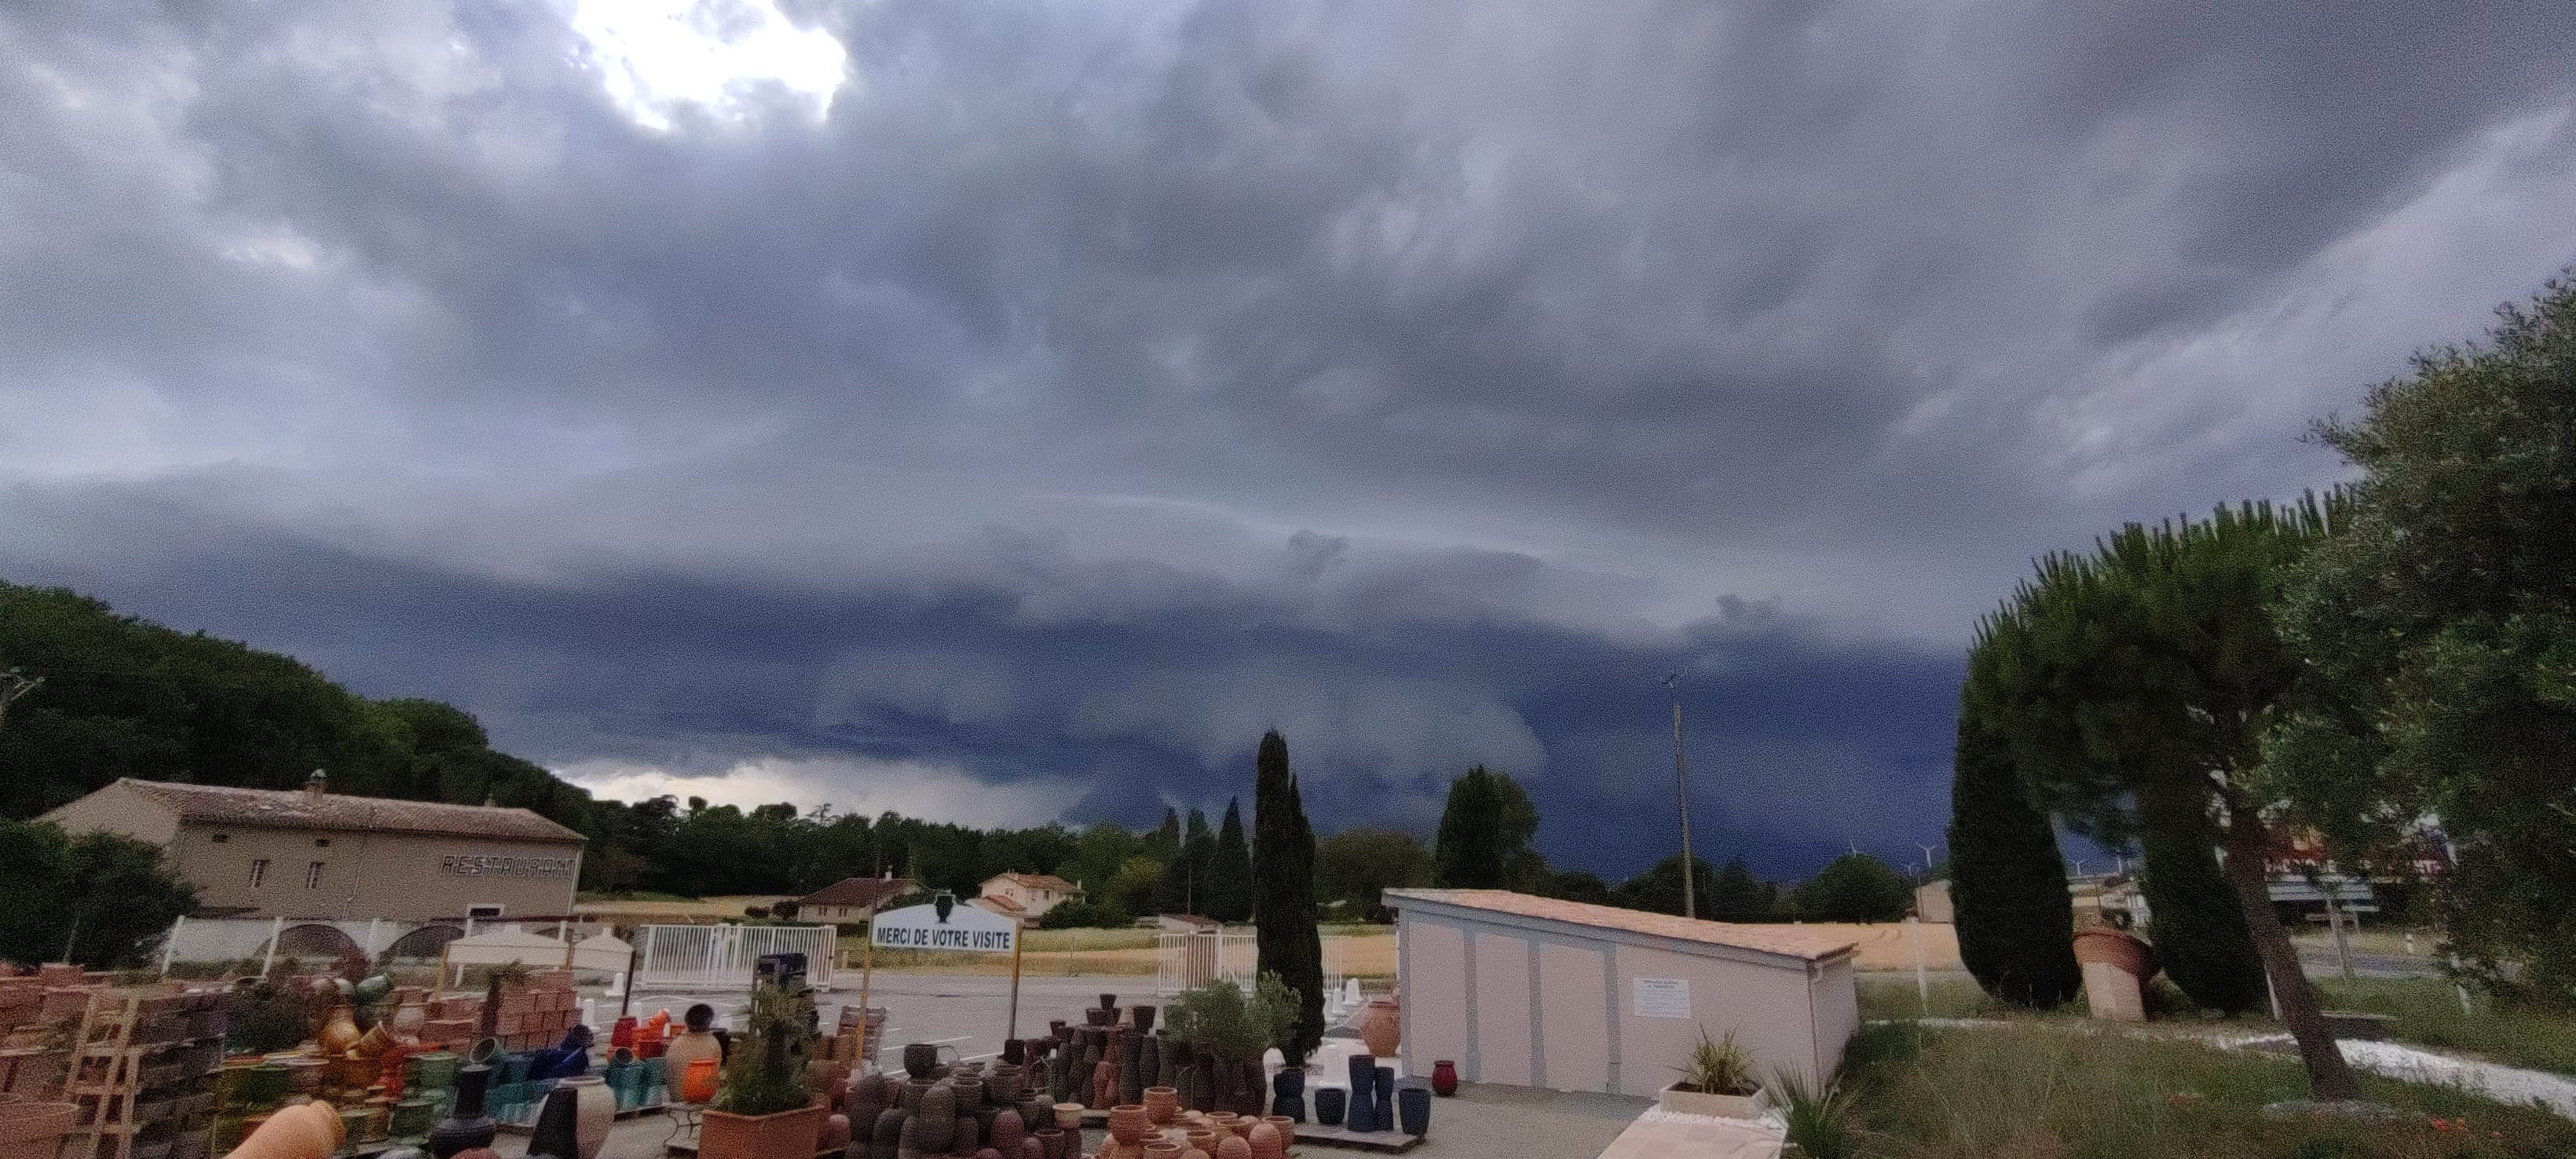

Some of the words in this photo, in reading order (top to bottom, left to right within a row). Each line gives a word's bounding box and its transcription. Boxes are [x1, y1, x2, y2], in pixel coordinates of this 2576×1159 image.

[441, 856, 577, 877] RESTAURANT
[877, 927, 911, 945] MERCI
[914, 929, 928, 945] DE
[932, 930, 968, 948] VOTRE
[973, 931, 1010, 949] VISITE
